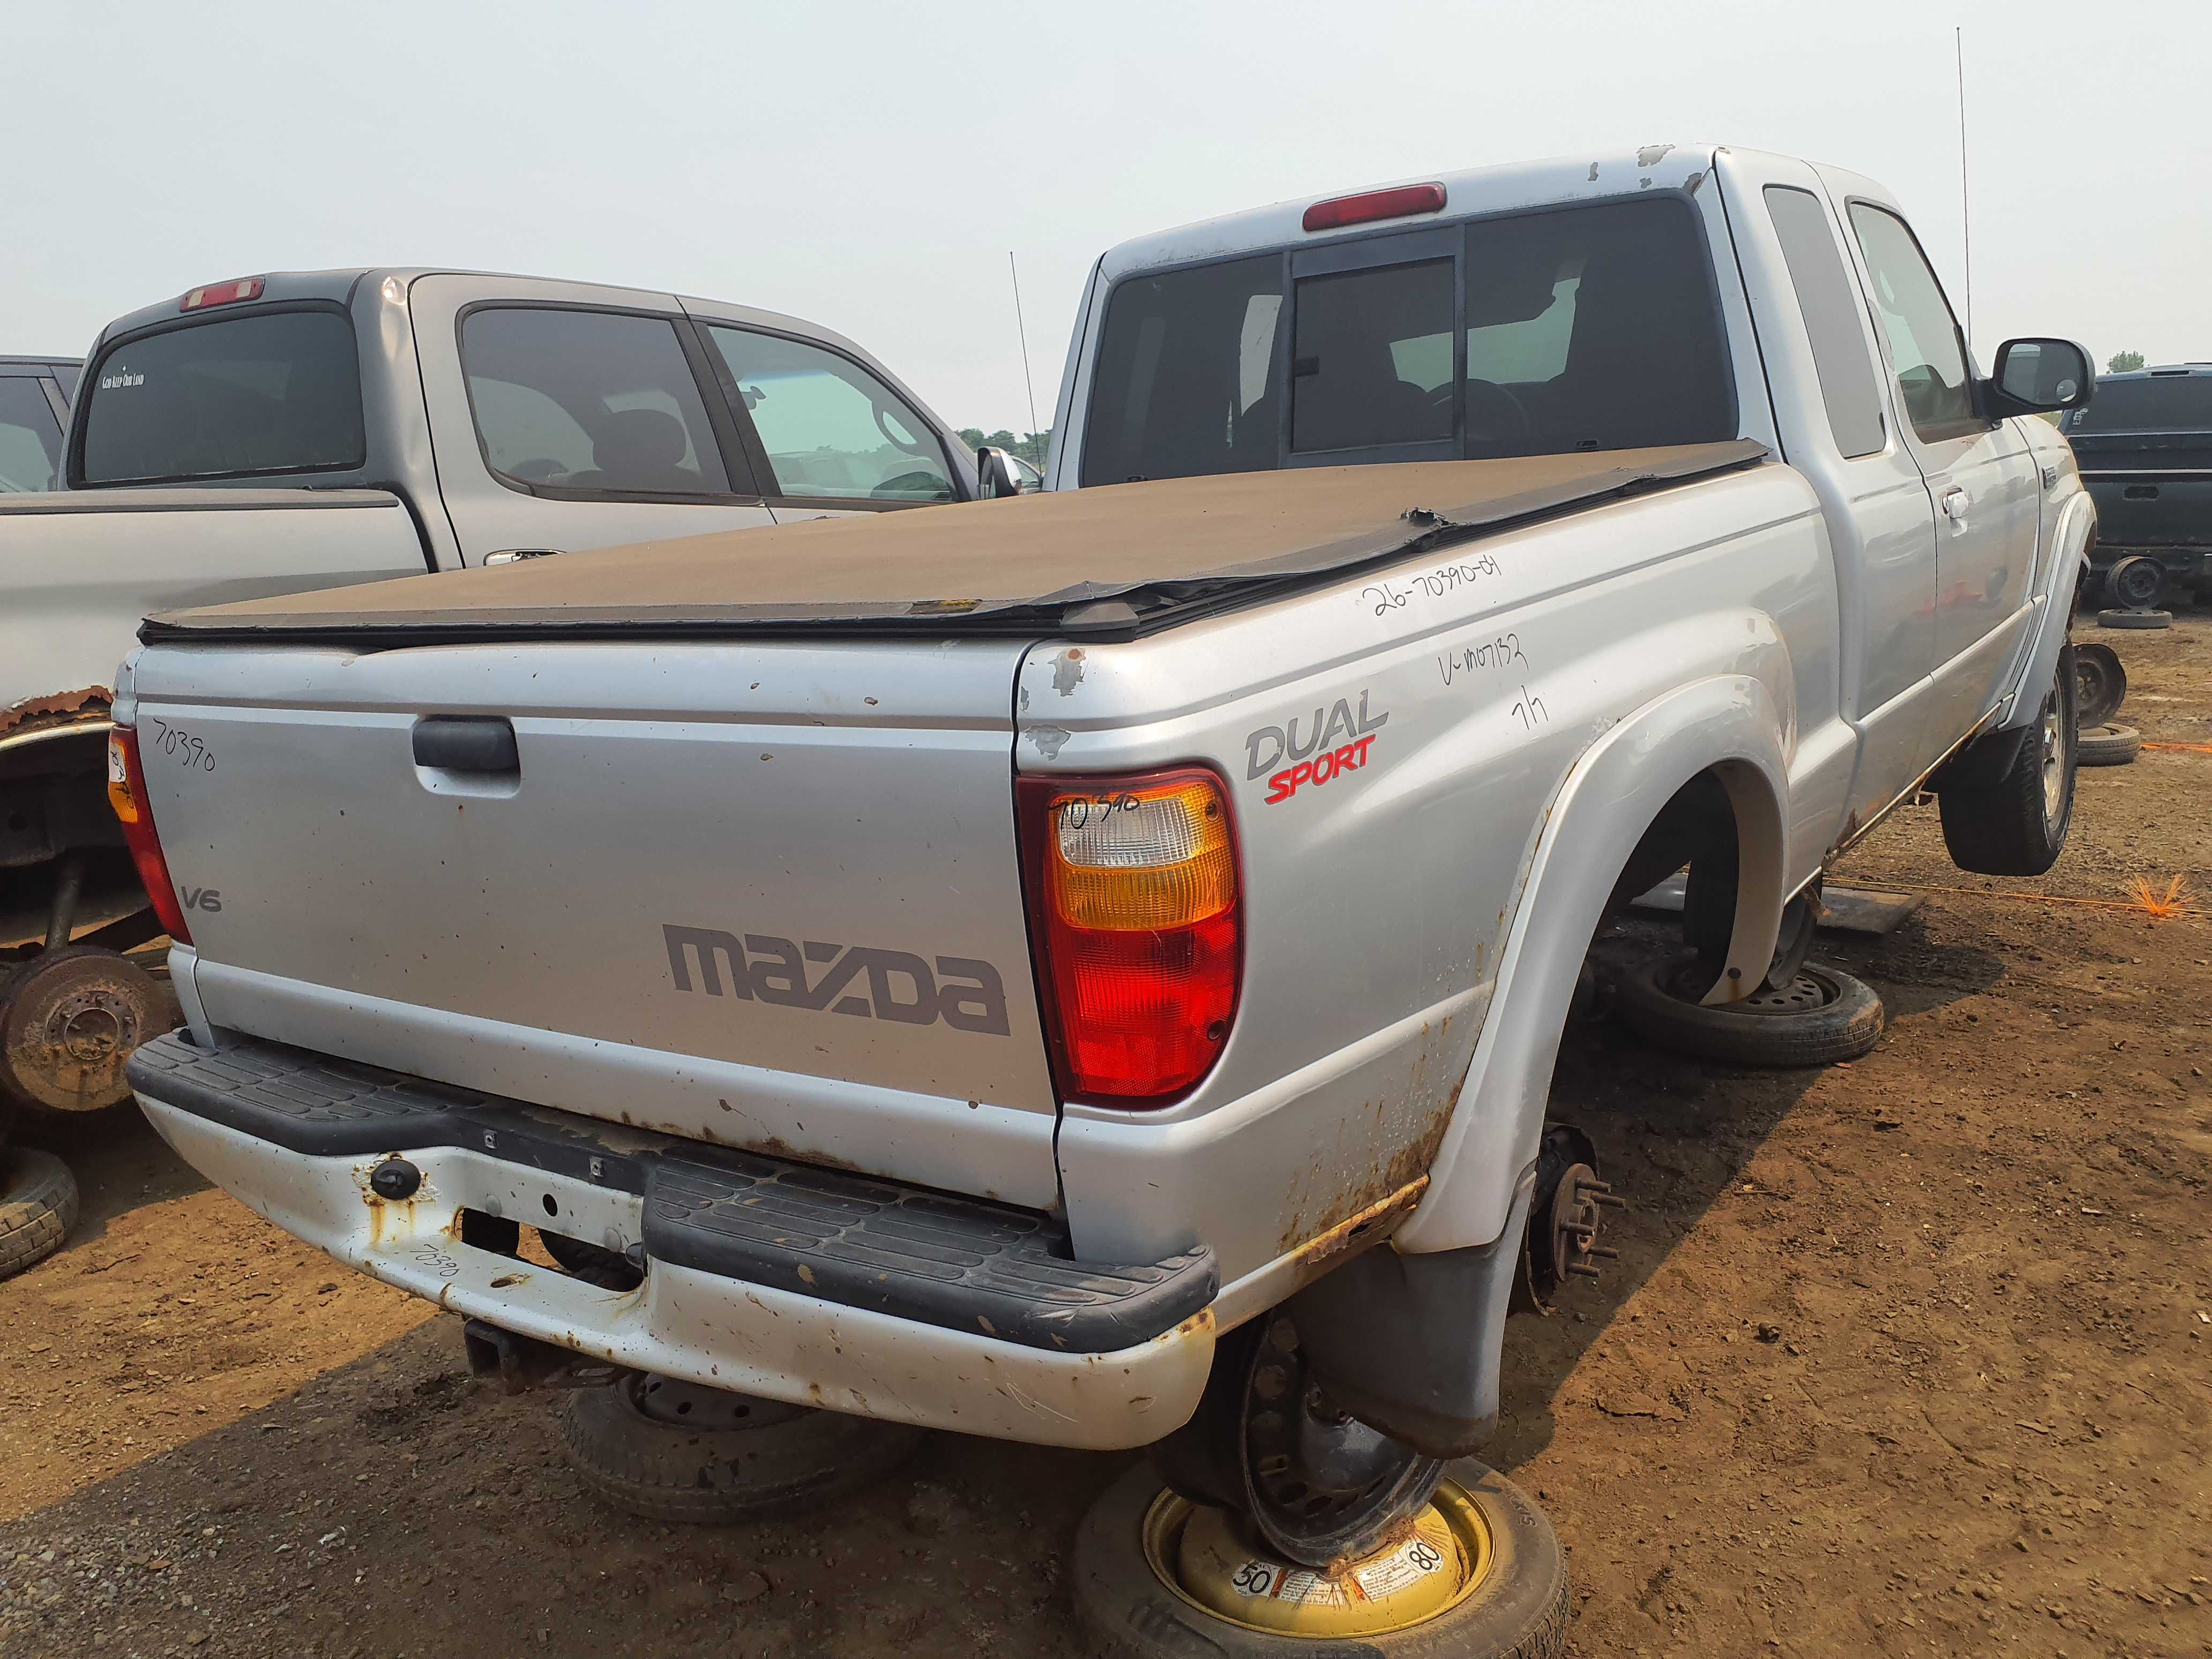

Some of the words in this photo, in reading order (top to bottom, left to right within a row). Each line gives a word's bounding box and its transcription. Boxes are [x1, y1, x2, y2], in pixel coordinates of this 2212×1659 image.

[153, 717, 215, 772] 70390
[1245, 689, 1389, 781] DUAL
[1264, 733, 1377, 805] SPORT
[181, 886, 222, 913] V6
[409, 1244, 460, 1277] 70390
[1409, 1542, 1440, 1571] 80
[1232, 1561, 1271, 1594] 50
